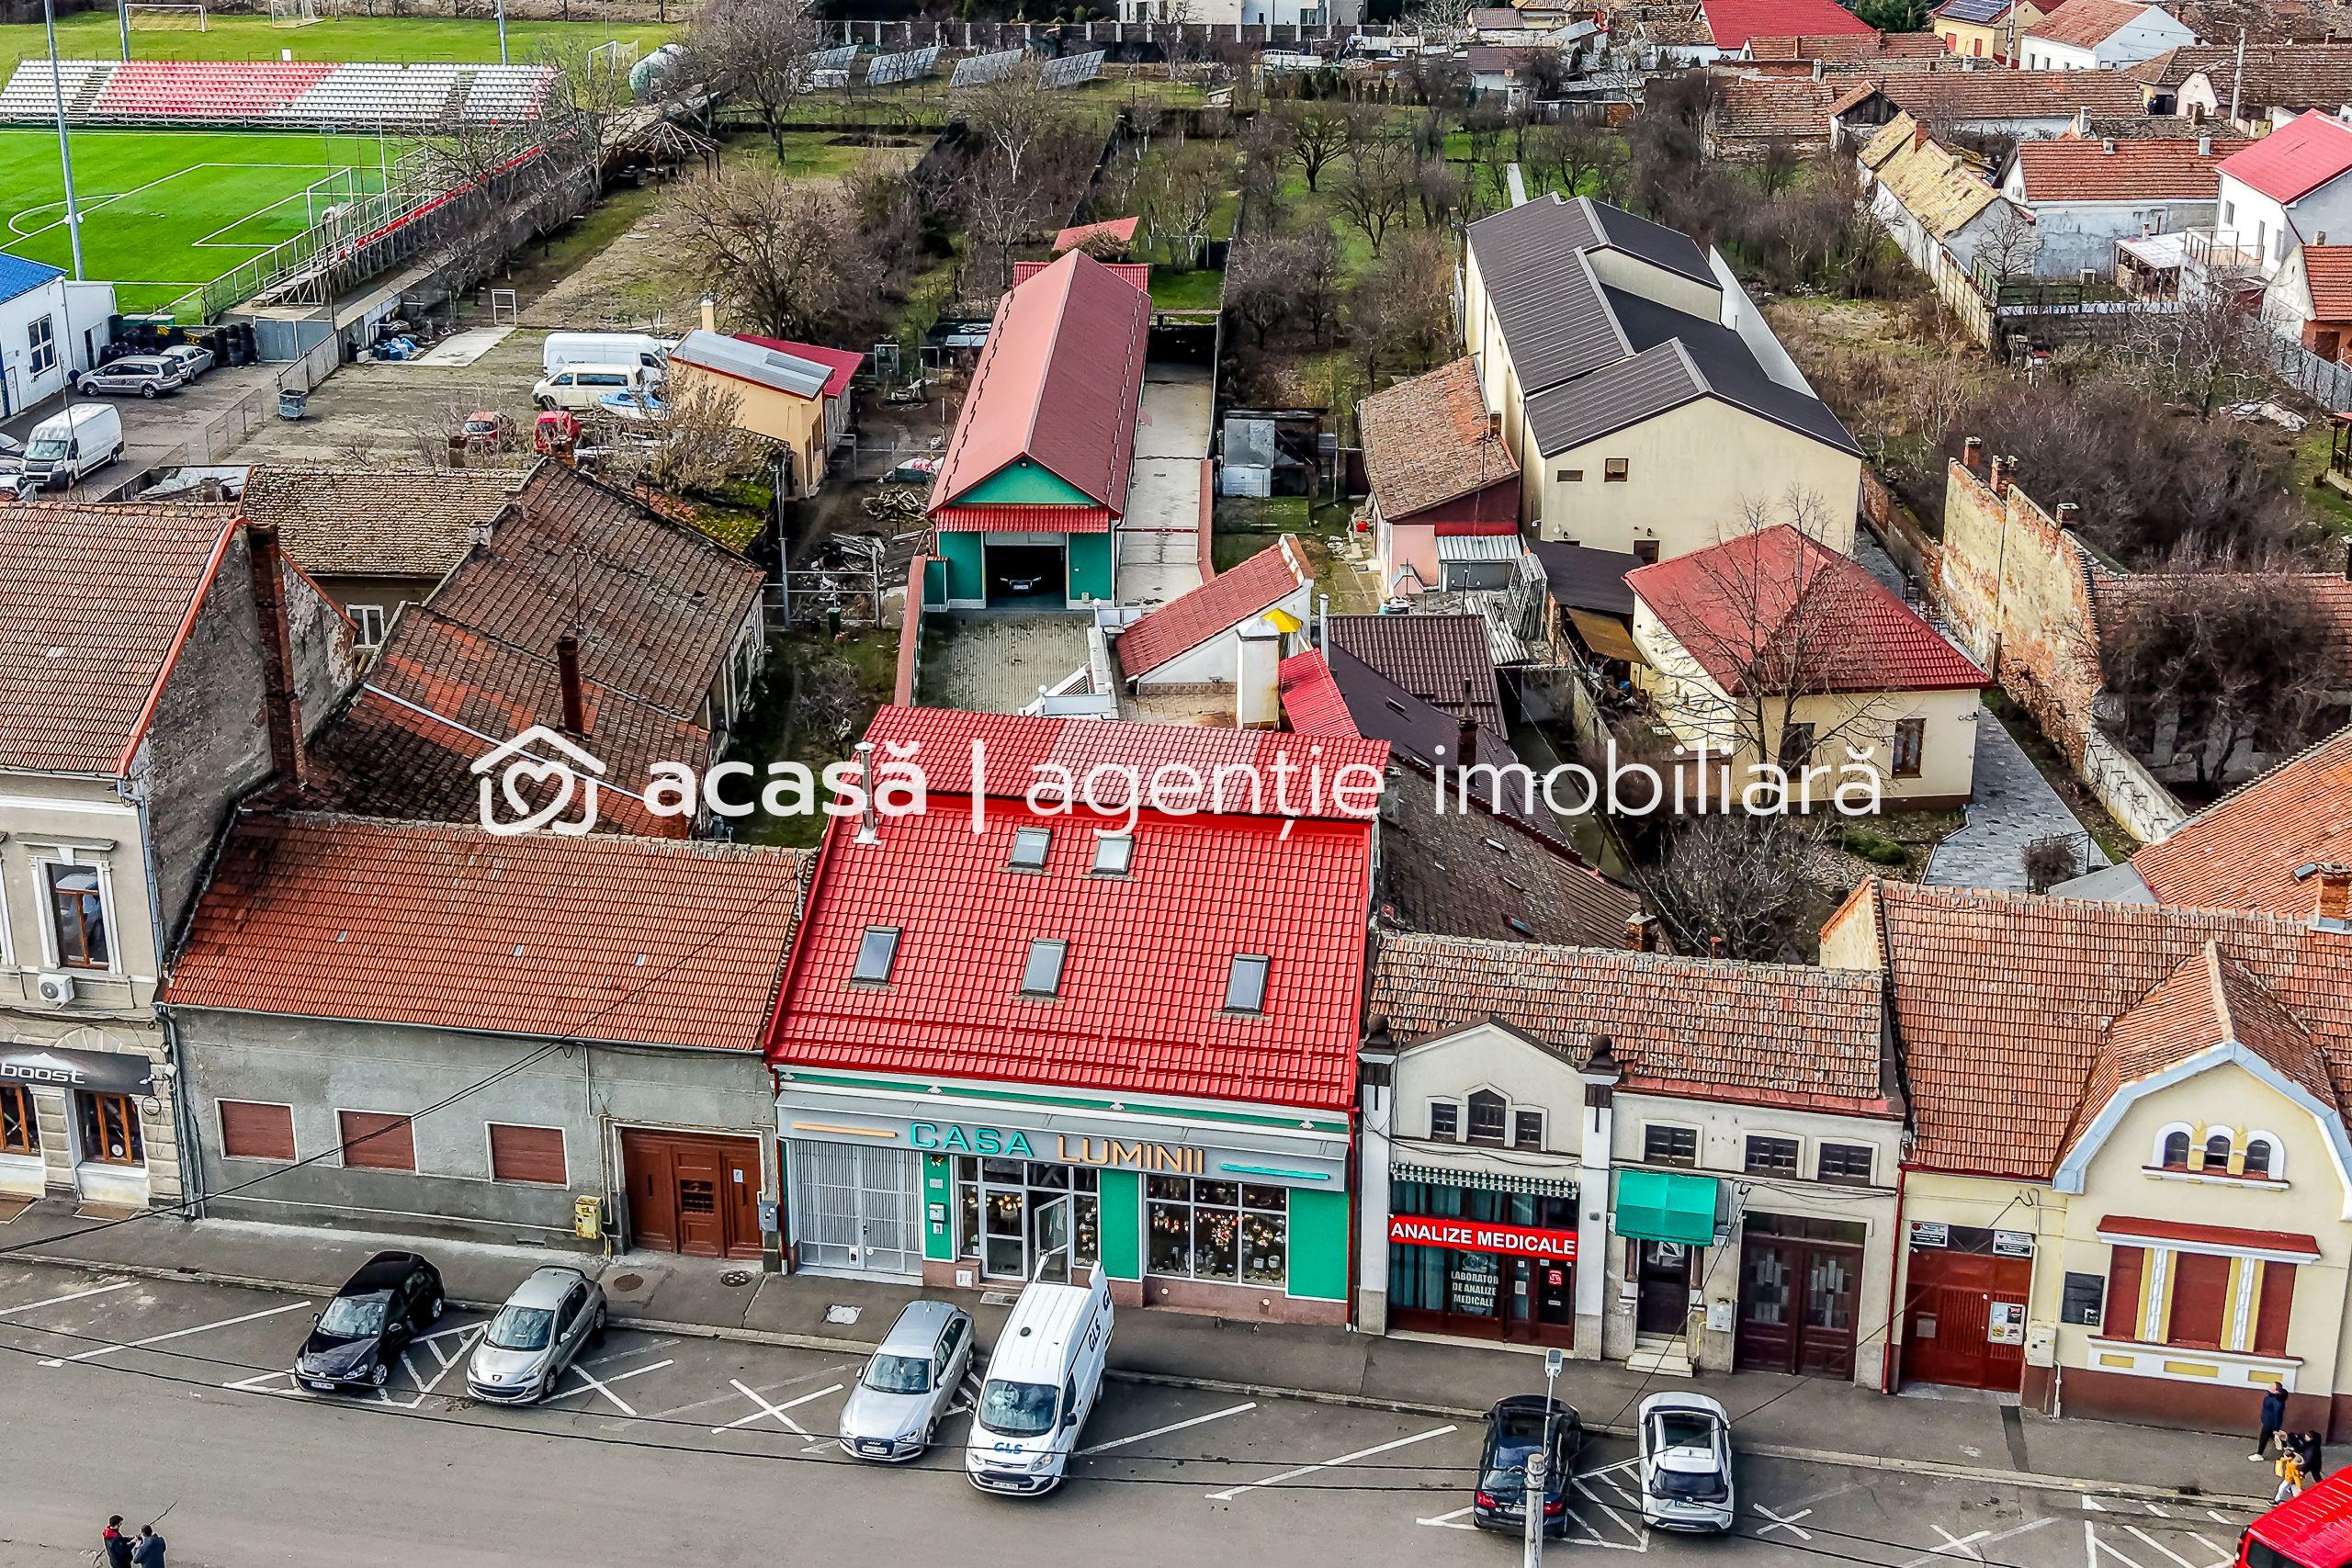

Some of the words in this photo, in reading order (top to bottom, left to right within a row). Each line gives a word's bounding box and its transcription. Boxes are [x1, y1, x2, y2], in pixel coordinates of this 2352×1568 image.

[1, 1062, 85, 1085] boost
[910, 1122, 1035, 1158] CASA
[1057, 1134, 1205, 1175] LUMINII
[1390, 1222, 1473, 1245] ANALIZE
[1476, 1230, 1577, 1256] MEDICALE
[1452, 1282, 1463, 1292] DE
[1464, 1283, 1497, 1296] ANALIZE
[1453, 1293, 1494, 1307] MEDICALE
[1089, 1317, 1101, 1352] GLS
[993, 1441, 1023, 1455] GLS
